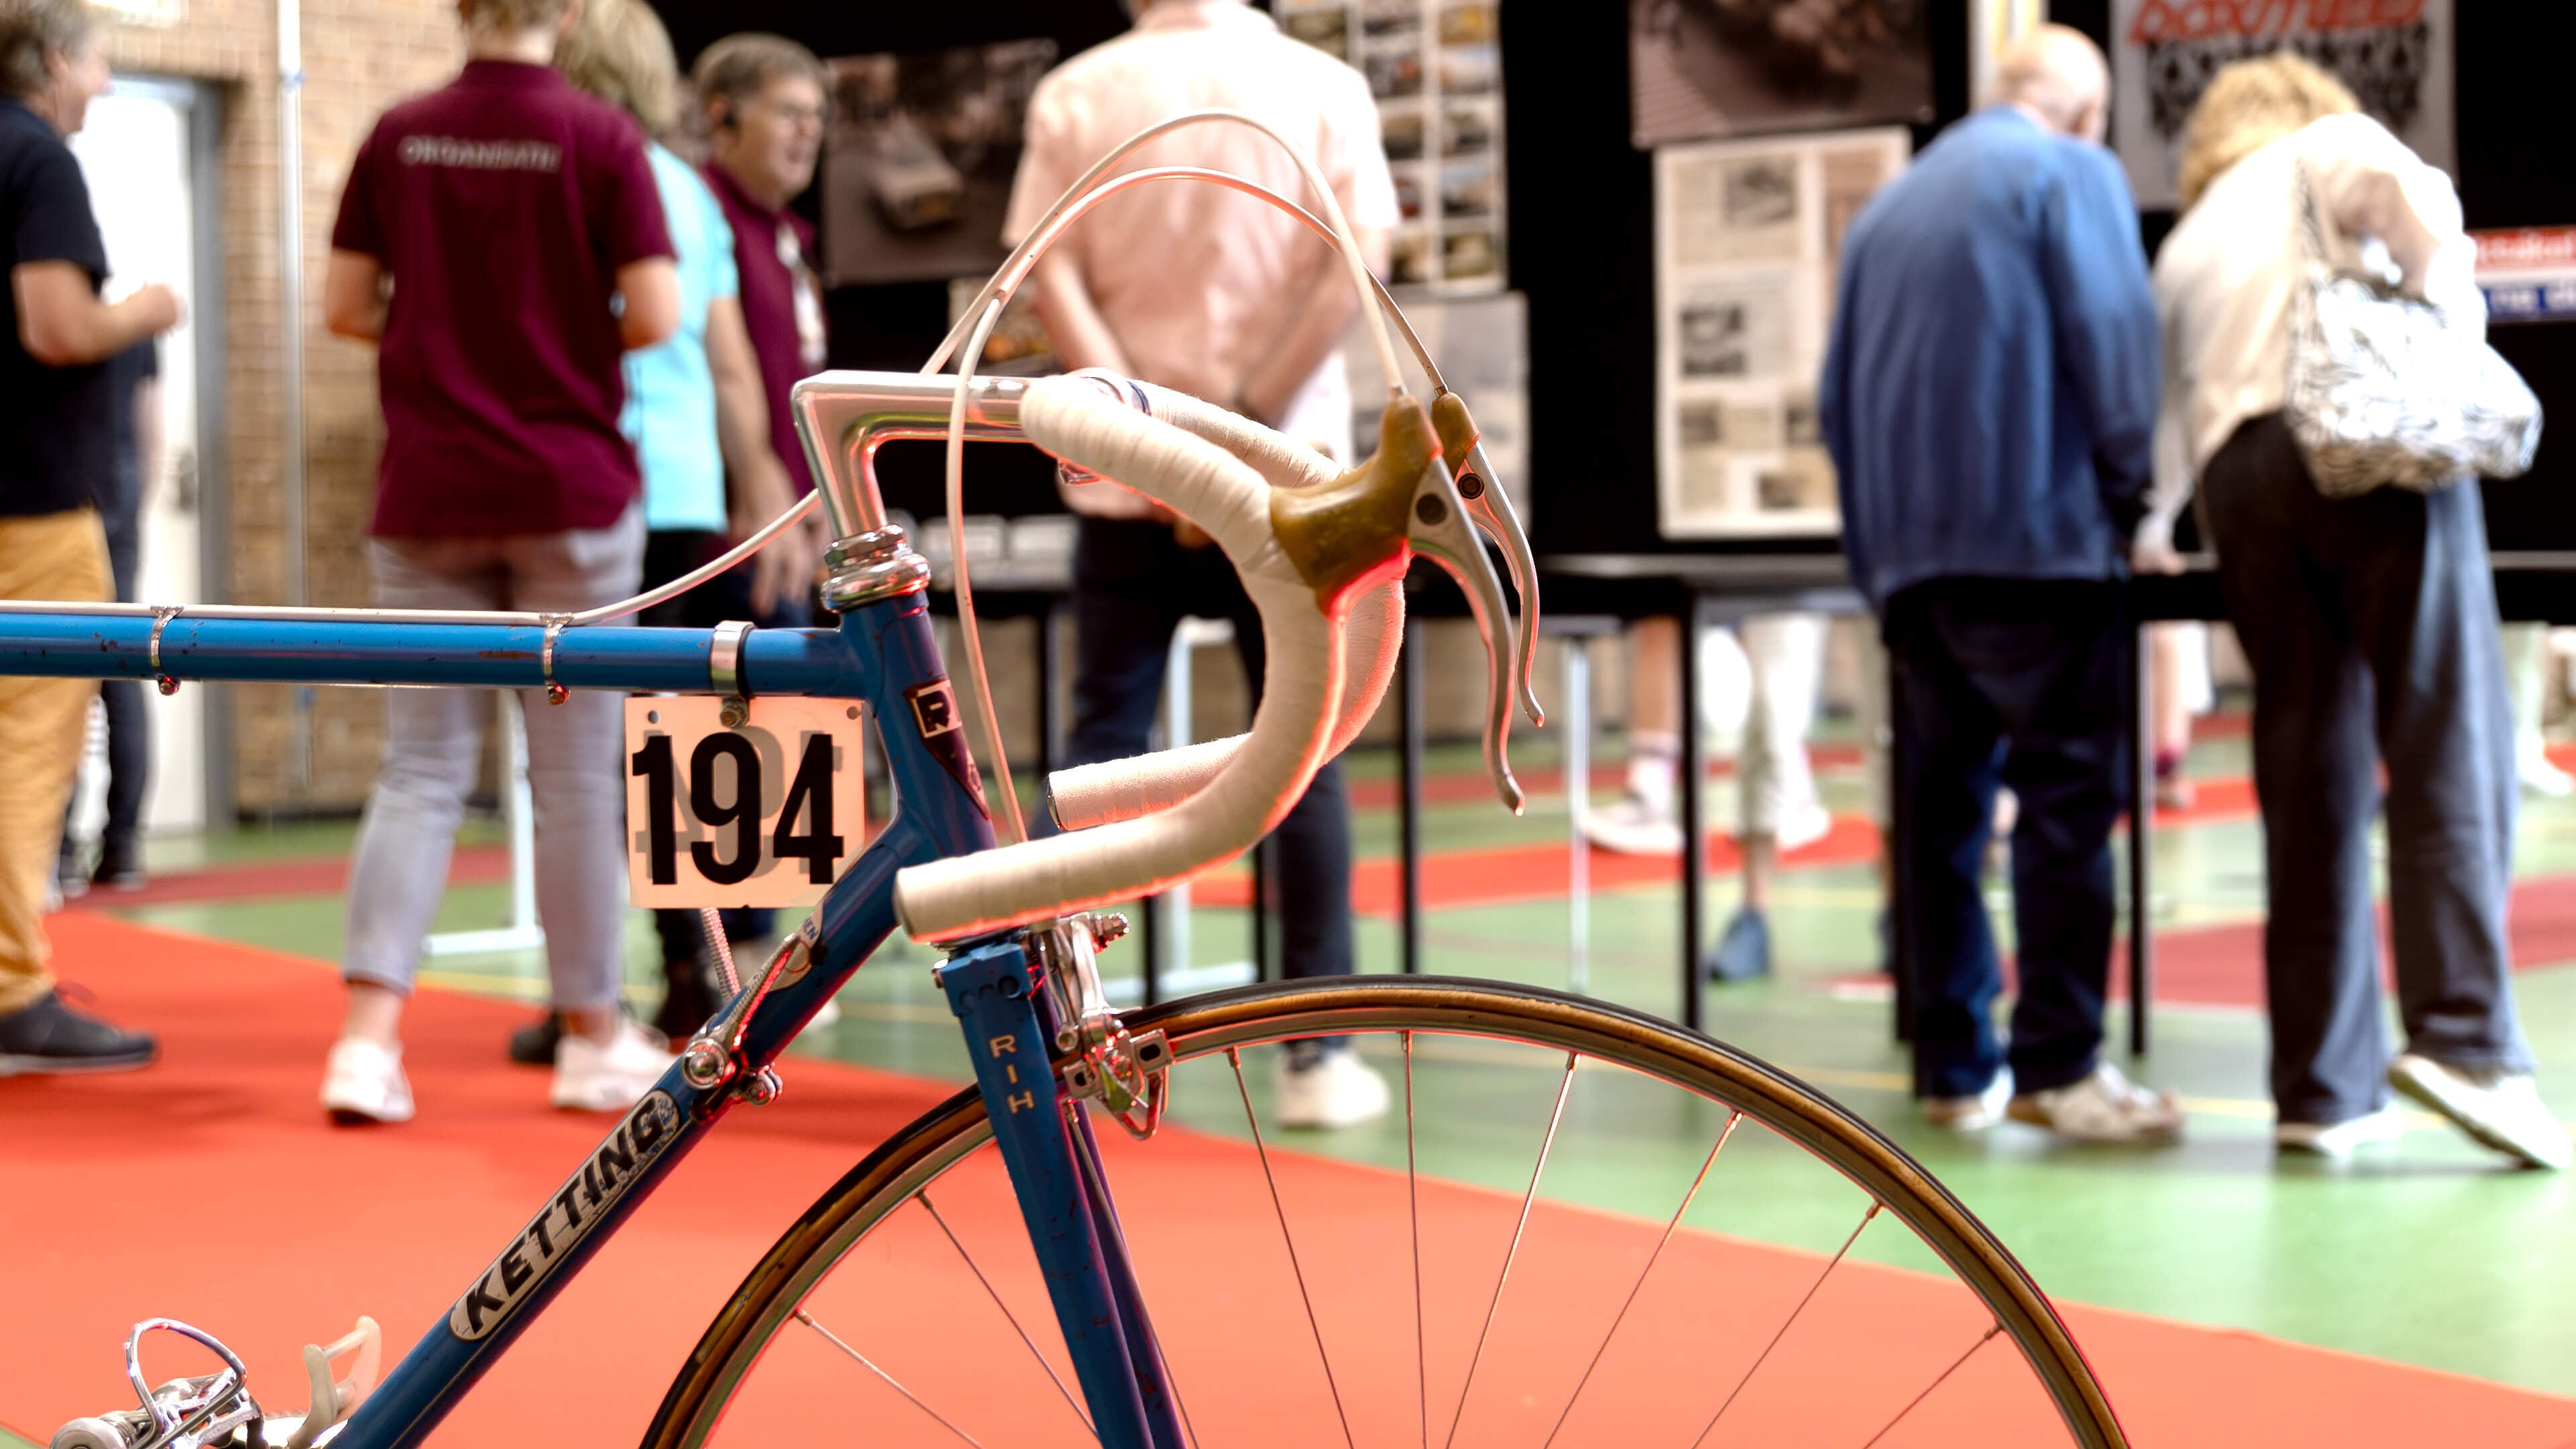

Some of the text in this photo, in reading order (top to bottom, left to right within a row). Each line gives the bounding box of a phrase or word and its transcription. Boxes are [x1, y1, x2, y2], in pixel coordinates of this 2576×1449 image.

[633, 732, 844, 885] 194
[989, 1034, 1034, 1114] RIH
[466, 1097, 664, 1334] KETTING
